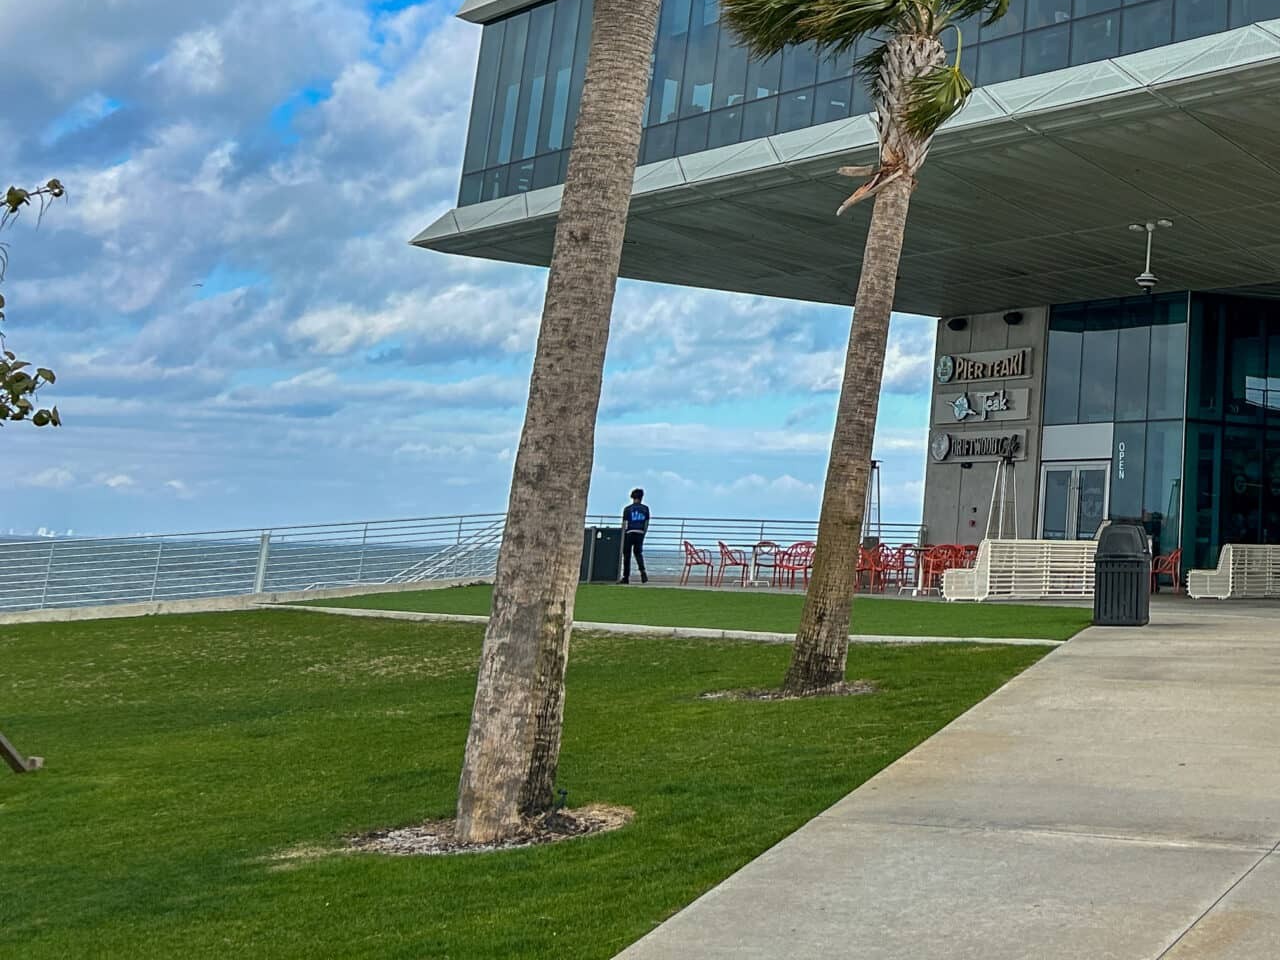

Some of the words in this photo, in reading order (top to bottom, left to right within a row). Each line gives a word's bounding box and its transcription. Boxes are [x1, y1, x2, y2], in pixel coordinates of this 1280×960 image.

[955, 356, 984, 380] PIER
[987, 350, 1026, 377] TEAKI
[977, 389, 1009, 421] Teak
[951, 437, 999, 457] DRIFTWOOD
[1118, 441, 1126, 480] OPEN
